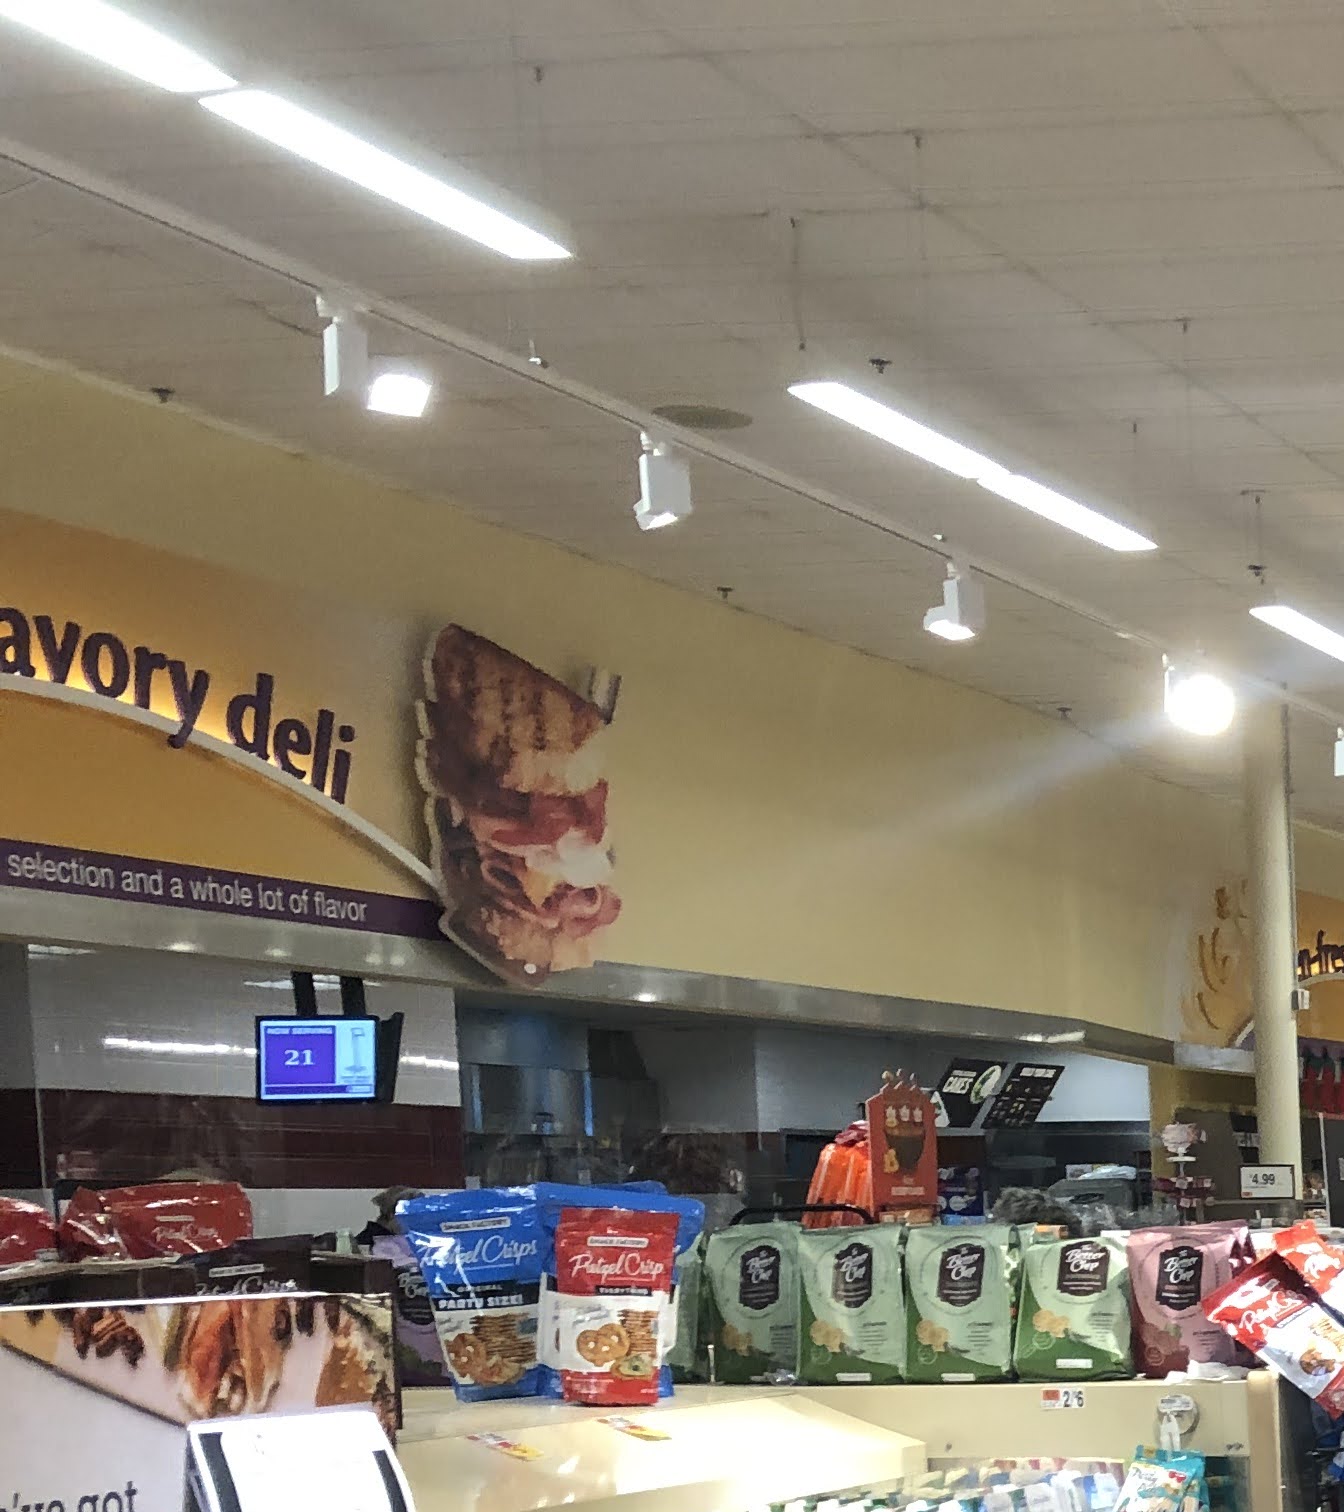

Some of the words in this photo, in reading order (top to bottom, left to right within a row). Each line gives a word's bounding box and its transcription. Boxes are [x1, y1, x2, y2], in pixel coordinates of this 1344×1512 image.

[227, 673, 355, 804] deli
[7, 852, 114, 890] selection
[121, 869, 164, 896] and
[170, 876, 184, 899] a
[190, 878, 252, 908] whole
[257, 882, 285, 911] lot
[288, 889, 309, 914] of
[313, 891, 367, 922] flavor
[284, 1049, 314, 1066] 21
[482, 1234, 537, 1264] Crisps
[569, 1254, 623, 1284] Pretzel
[438, 1295, 484, 1309] PARTY
